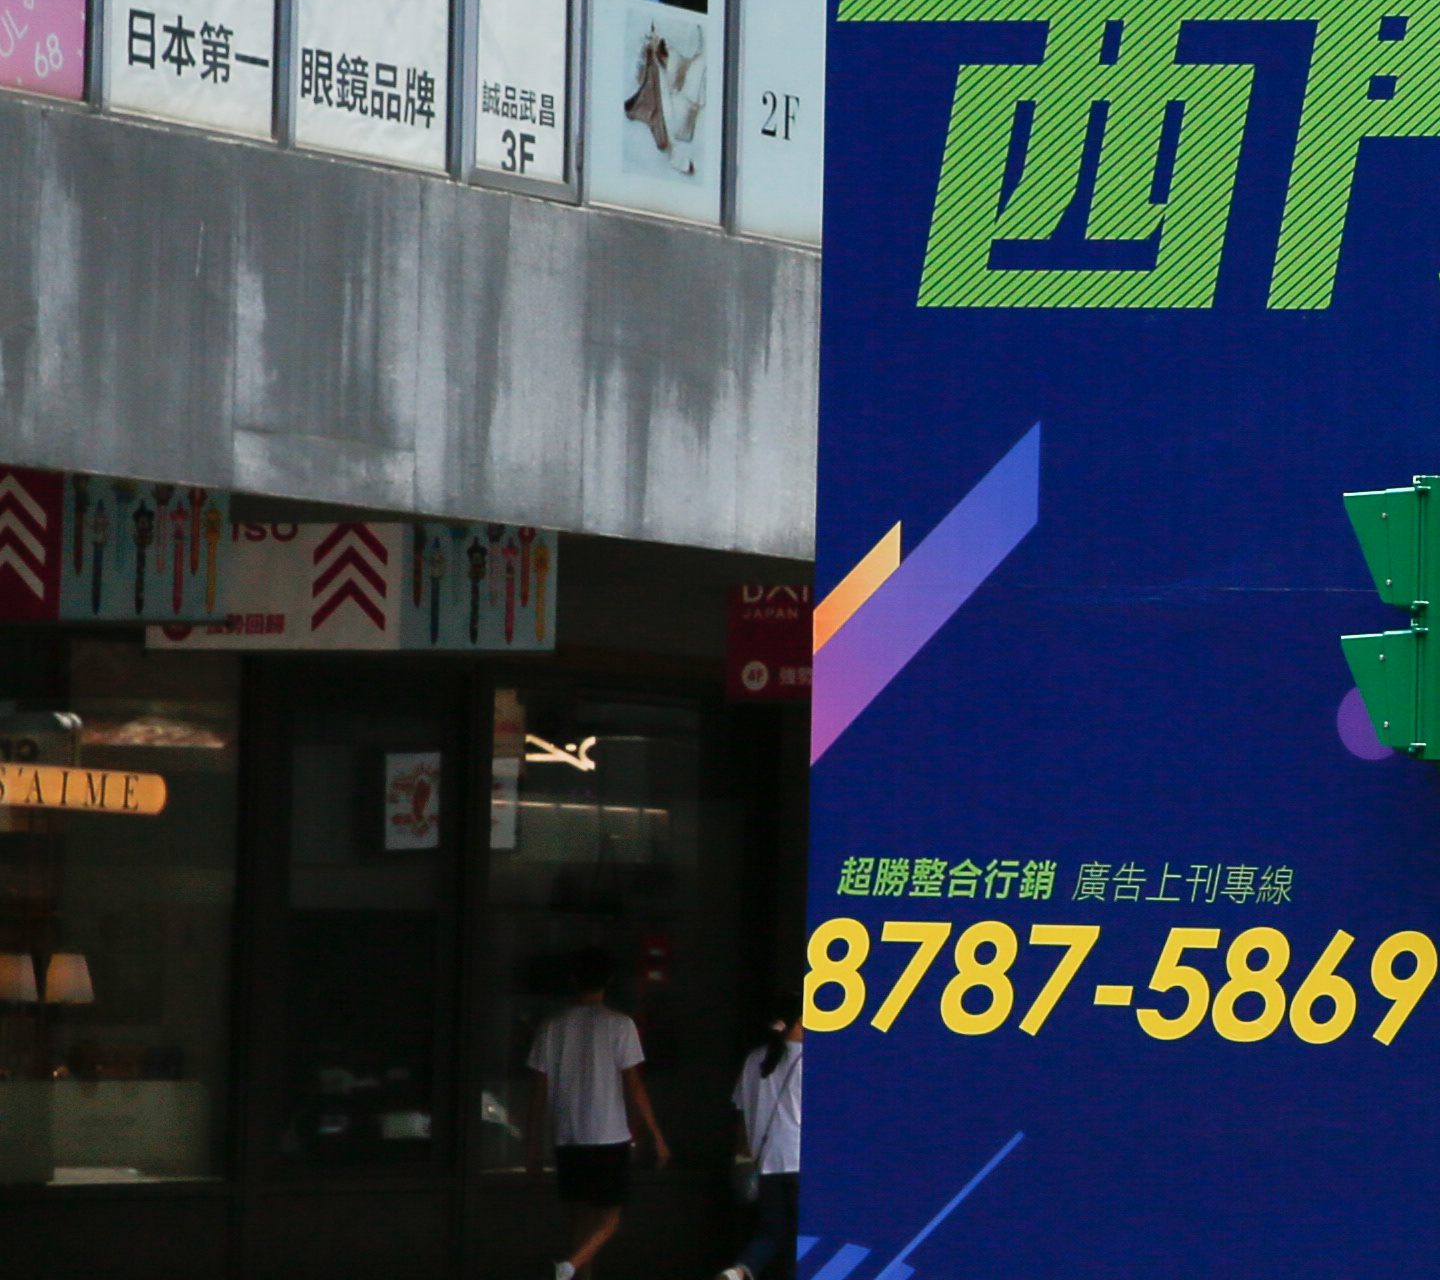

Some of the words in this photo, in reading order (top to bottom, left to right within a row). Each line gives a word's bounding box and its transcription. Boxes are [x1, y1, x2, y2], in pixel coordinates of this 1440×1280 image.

[34, 32, 64, 79] 68
[127, 7, 270, 84] 日本第一
[300, 47, 436, 129] 眼鏡品牌
[481, 79, 556, 129] 誠品武昌
[761, 89, 801, 142] 2F
[501, 129, 536, 175] 3F
[836, 856, 1057, 901] 超勝整合行銷
[1071, 861, 1295, 905] 廣告上刊專線
[803, 917, 1439, 1046] 8787-5869
